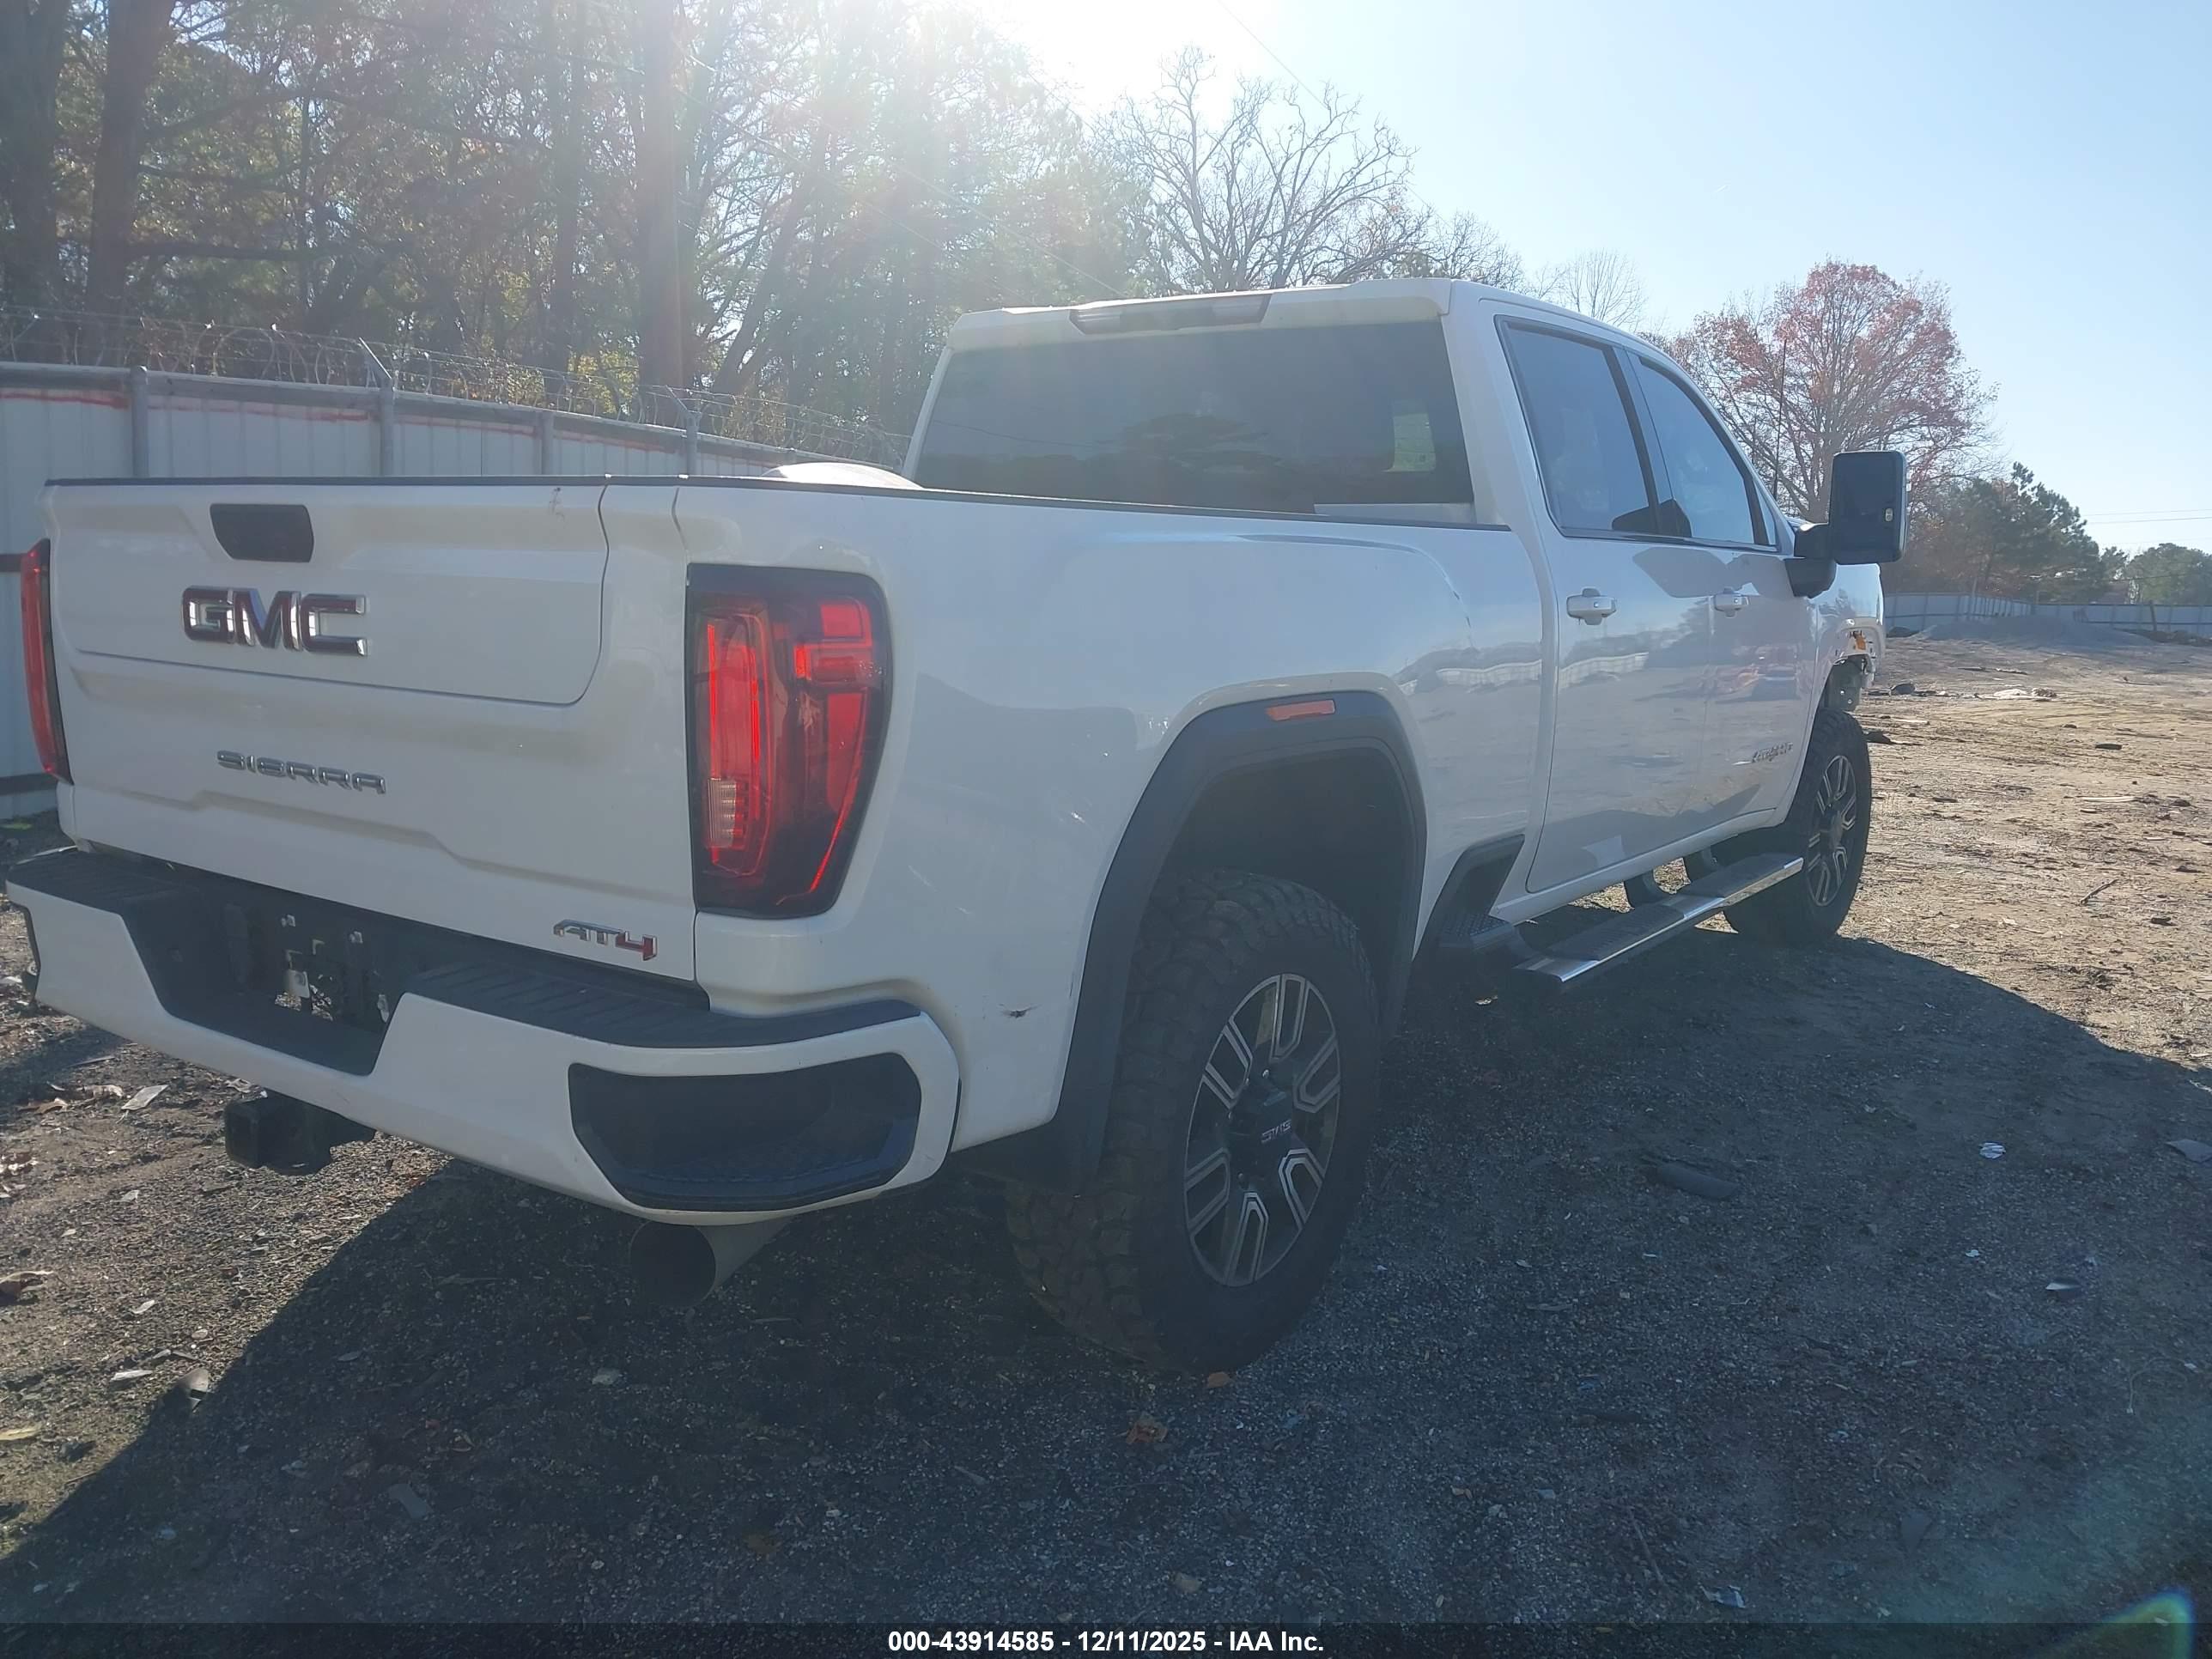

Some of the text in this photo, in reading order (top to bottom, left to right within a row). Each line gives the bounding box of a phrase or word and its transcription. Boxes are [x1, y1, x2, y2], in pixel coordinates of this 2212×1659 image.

[182, 586, 368, 656] GMC
[216, 750, 386, 794] SIERRA
[553, 919, 659, 962] AT4
